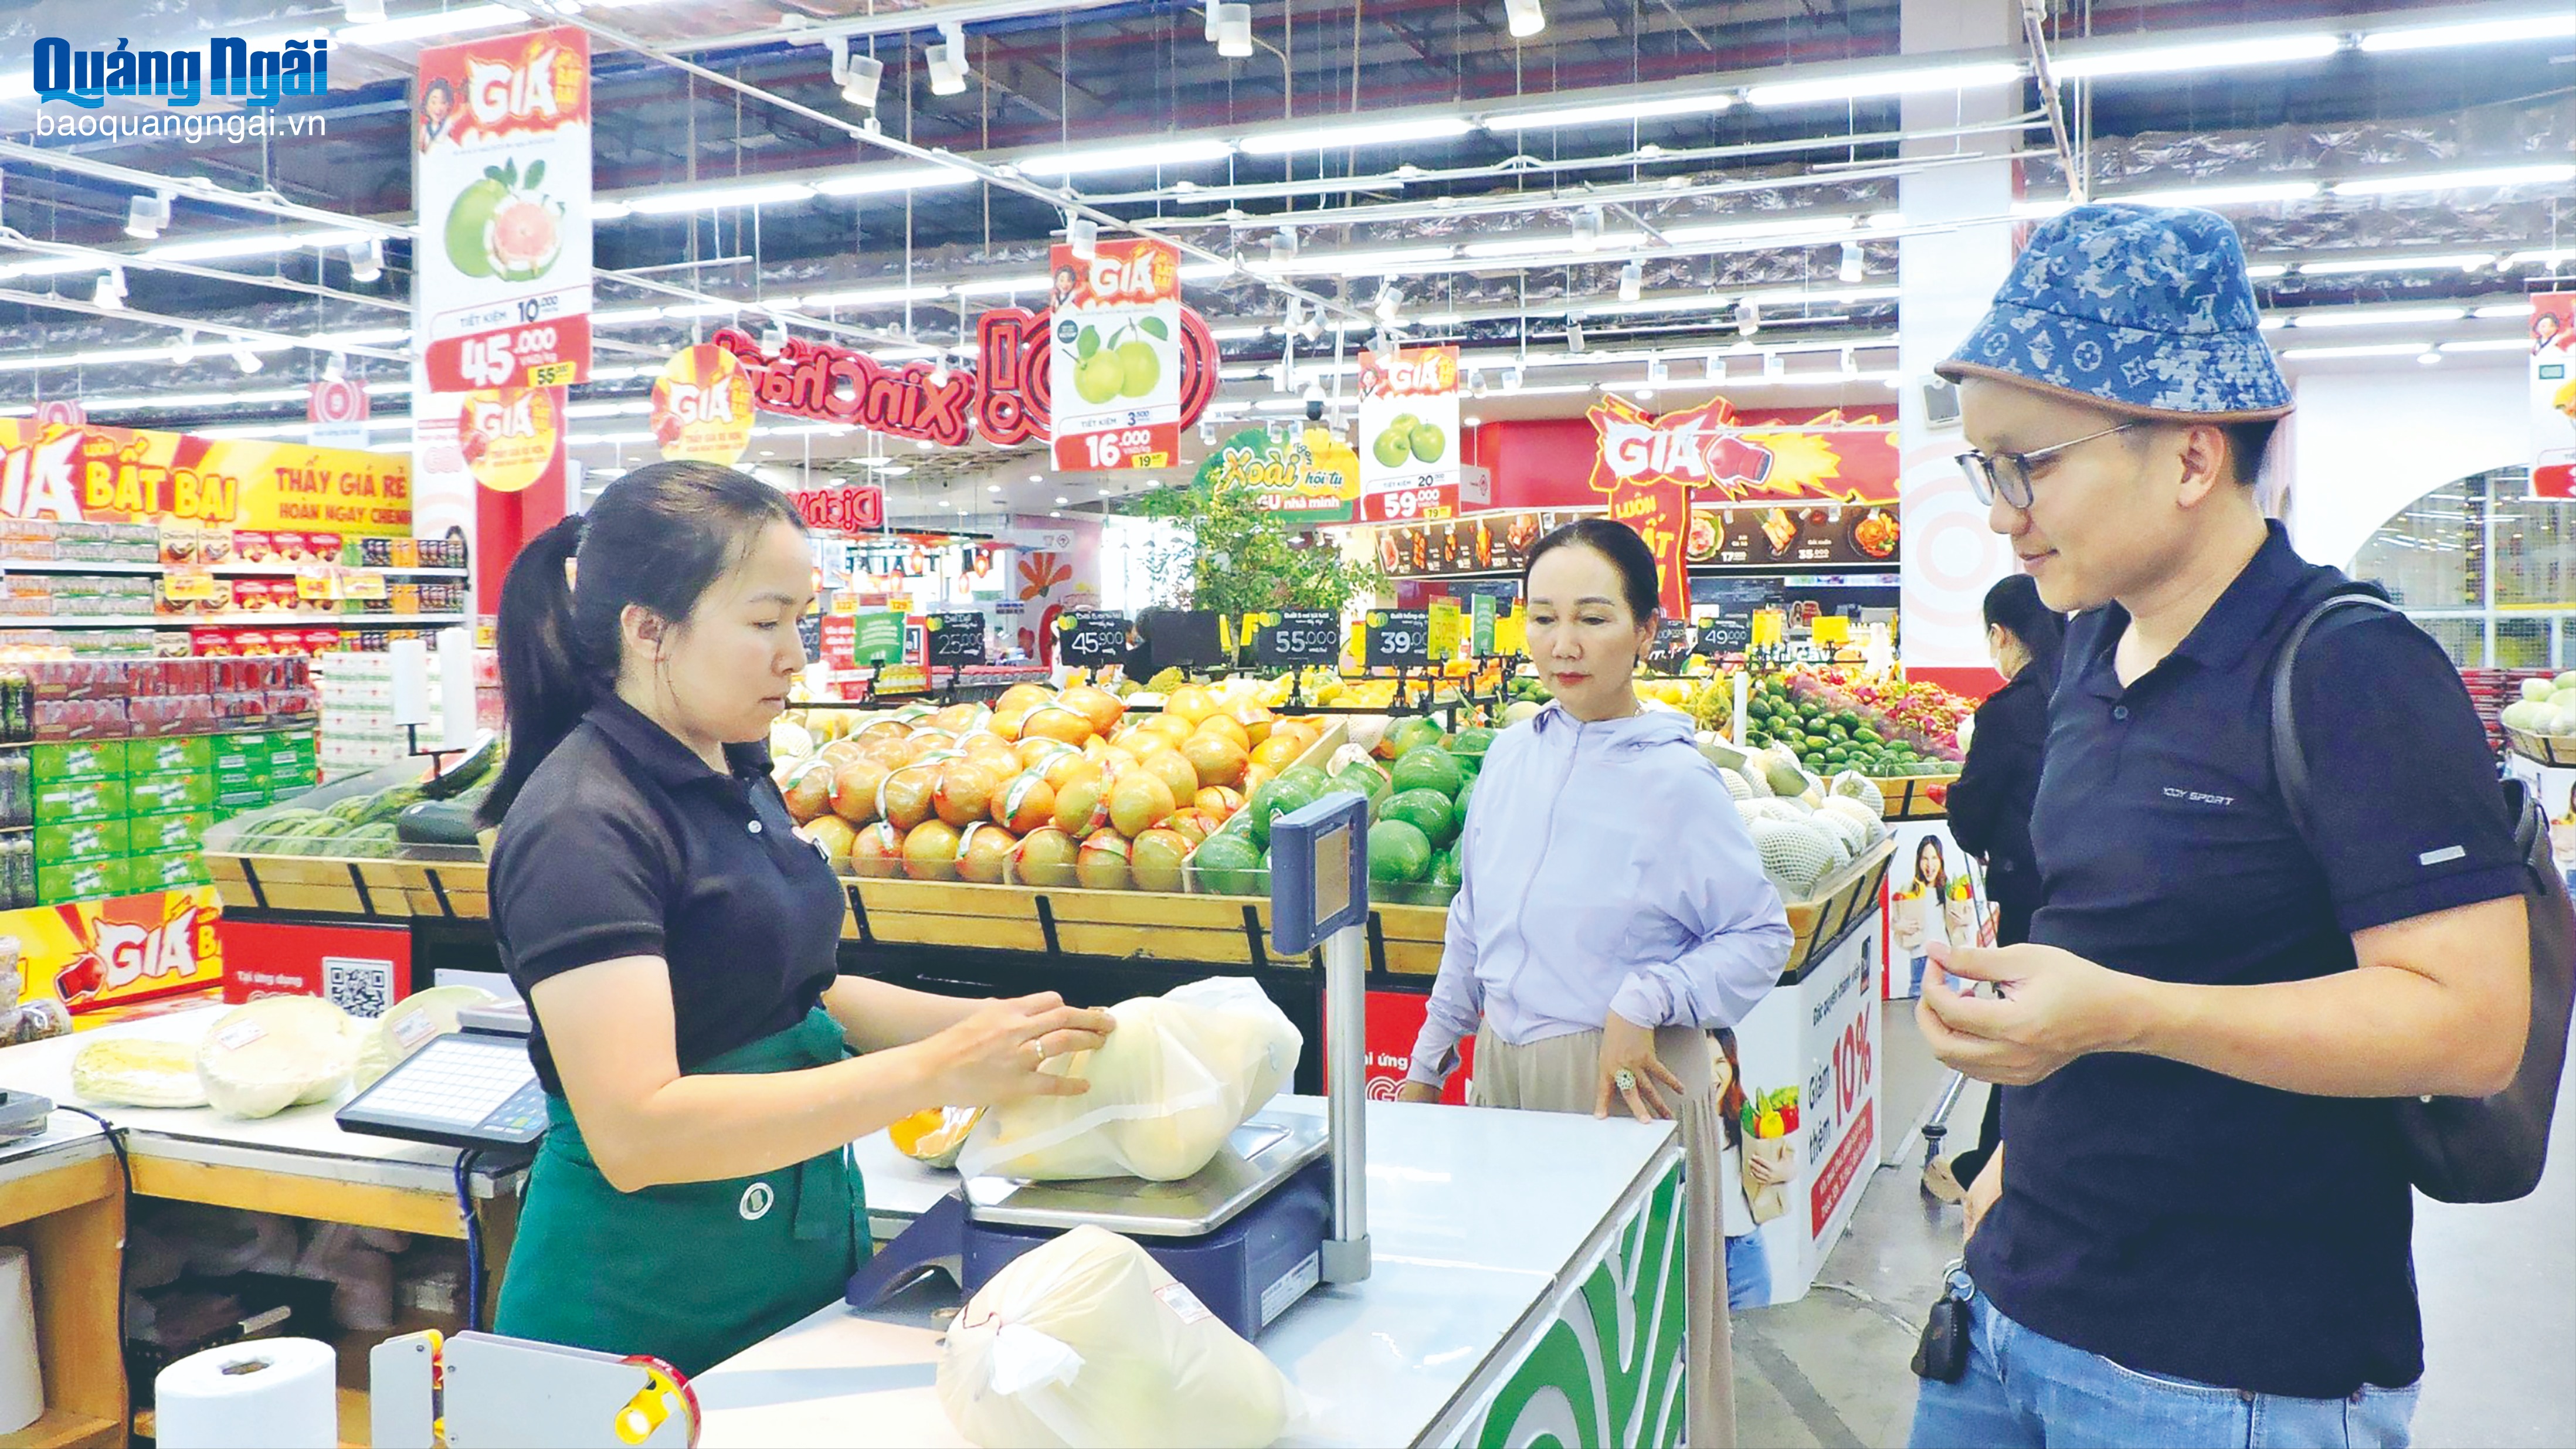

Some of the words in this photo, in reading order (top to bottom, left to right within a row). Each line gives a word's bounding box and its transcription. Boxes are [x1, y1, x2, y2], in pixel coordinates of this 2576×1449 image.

[469, 39, 558, 124] GIÁ
[1089, 242, 1157, 297] GIÁ
[461, 327, 557, 386] 45.000
[1387, 350, 1441, 391] GIÁ
[473, 389, 536, 440] GIÁ
[668, 367, 734, 425] GIÁ
[1086, 430, 1150, 467] 16.000
[0, 425, 84, 521] IÁ
[87, 437, 166, 514] BẤT
[175, 471, 236, 528] BẠI
[275, 454, 332, 494] THẤY
[340, 466, 376, 496] GIÁ
[1216, 450, 1299, 494] Xoài
[325, 505, 365, 522] NGAY
[1615, 493, 1657, 519] LUÔN
[1641, 513, 1675, 558] ẤT
[1072, 632, 1124, 654] 45.900
[1275, 630, 1336, 653] 55.000
[2189, 792, 2235, 805] SPORT
[94, 897, 198, 991] GIÁ
[1377, 1053, 1408, 1070] ứng
[1832, 1001, 1872, 1129] 10%
